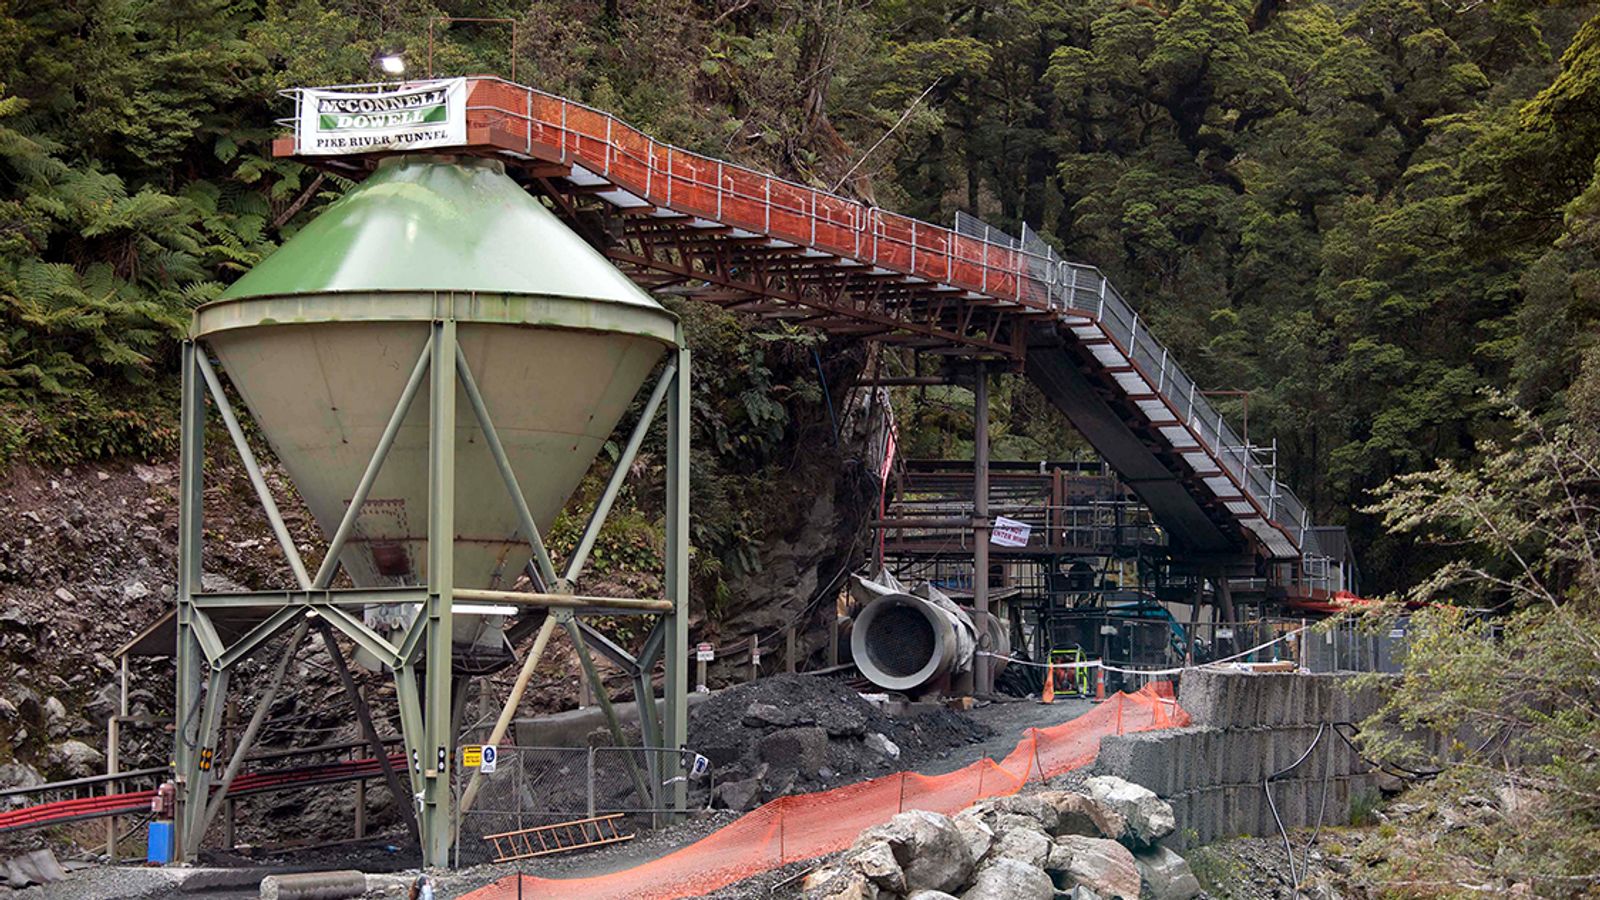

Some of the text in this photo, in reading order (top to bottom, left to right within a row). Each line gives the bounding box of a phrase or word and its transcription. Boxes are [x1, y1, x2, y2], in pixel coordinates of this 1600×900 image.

[336, 110, 425, 128] DOWELL
[317, 130, 447, 148] PIKE RIVER TUNNEL
[993, 530, 1012, 540] ENTER
